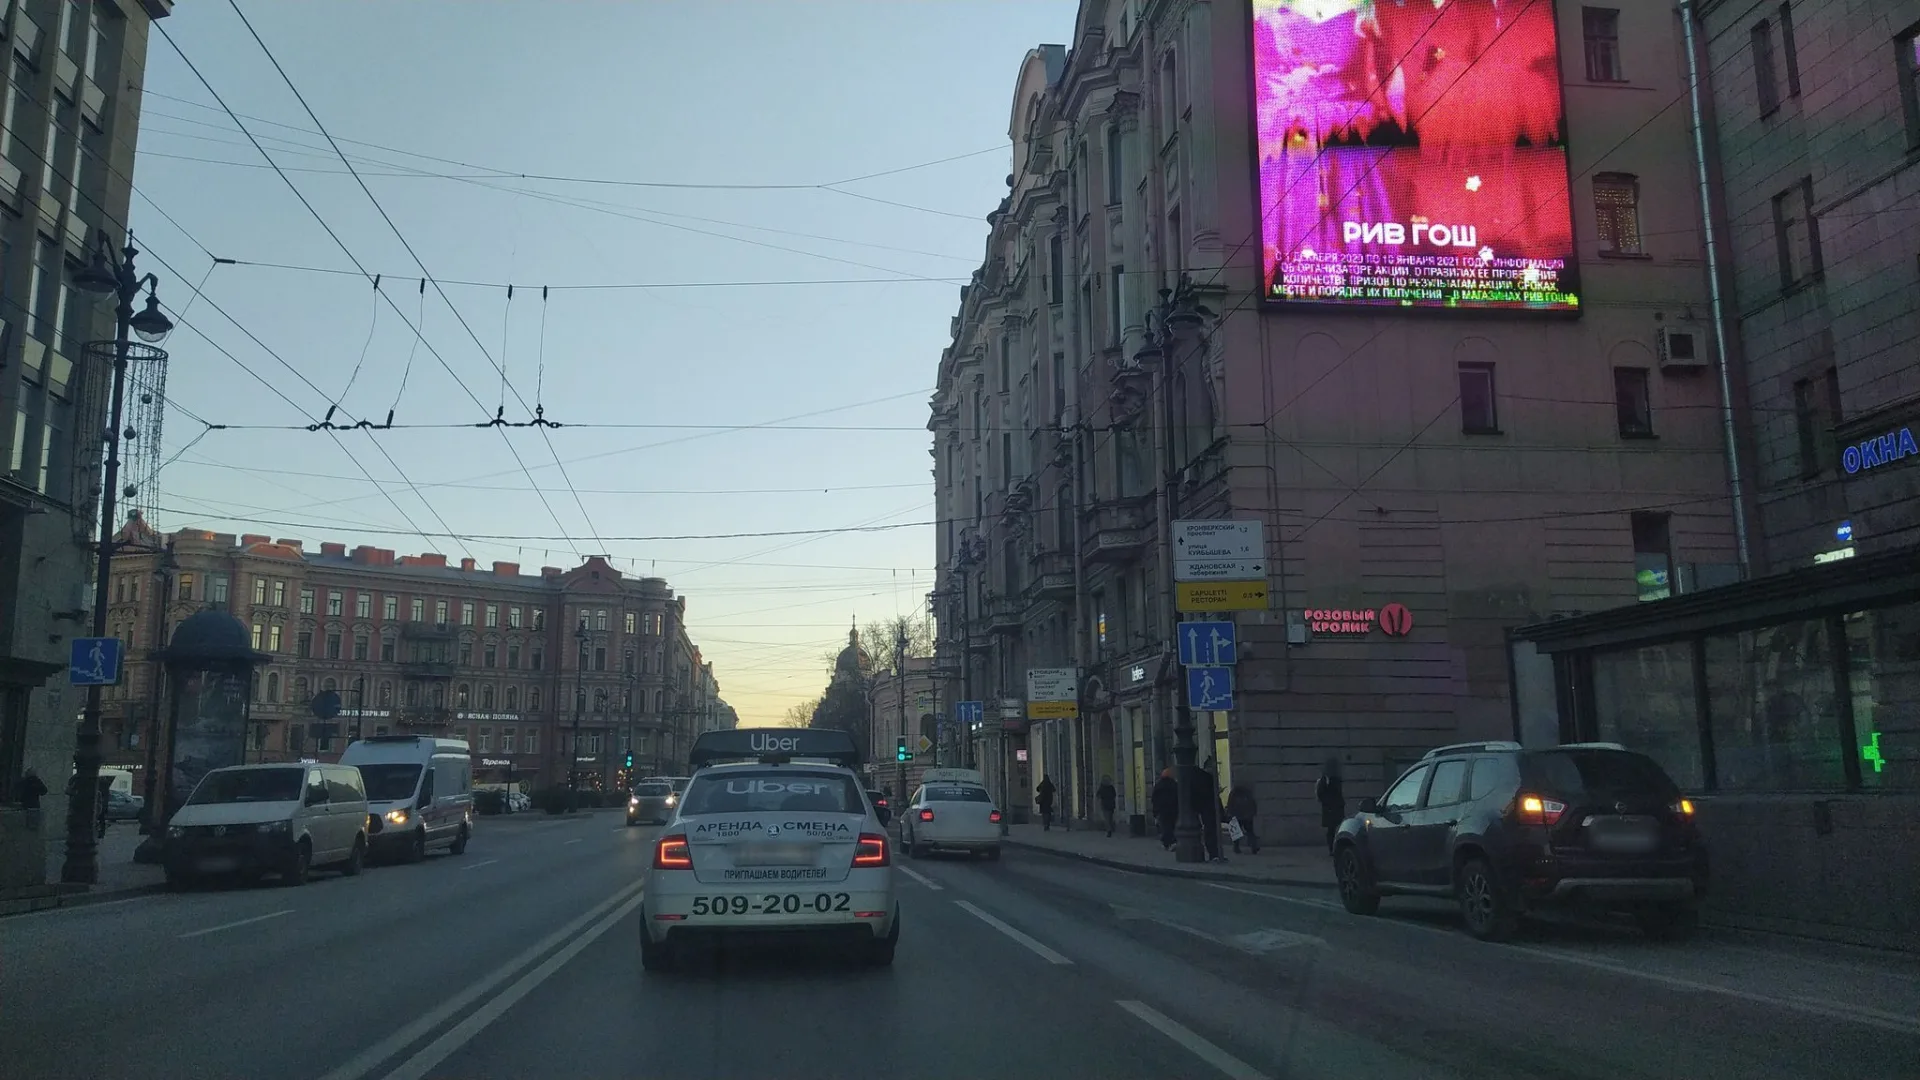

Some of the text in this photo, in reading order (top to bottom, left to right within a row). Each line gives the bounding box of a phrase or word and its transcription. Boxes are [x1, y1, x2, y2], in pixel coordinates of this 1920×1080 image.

[1343, 221, 1476, 247] РИВ ГОШ
[1437, 256, 1459, 267] 2021
[1492, 257, 1565, 269] ИНФОРМАЦИЯ
[1297, 263, 1372, 275] ОРГАНИЗАТОРЕ
[1272, 284, 1306, 295] МЕСТЕ
[1842, 427, 1919, 474] ОКНА
[1188, 548, 1232, 556] КУЙБЫШЕВА
[1304, 608, 1374, 621] РОЗОВЫЙ
[1311, 621, 1370, 633] КРОЛИК
[750, 733, 800, 751] Uber
[695, 821, 849, 833] АРЕНДА СМЕНА
[724, 868, 827, 880] ПРИГЛАШАЕМ ВОДИТЕЛЕЙ
[691, 892, 850, 916] 509-20-02
